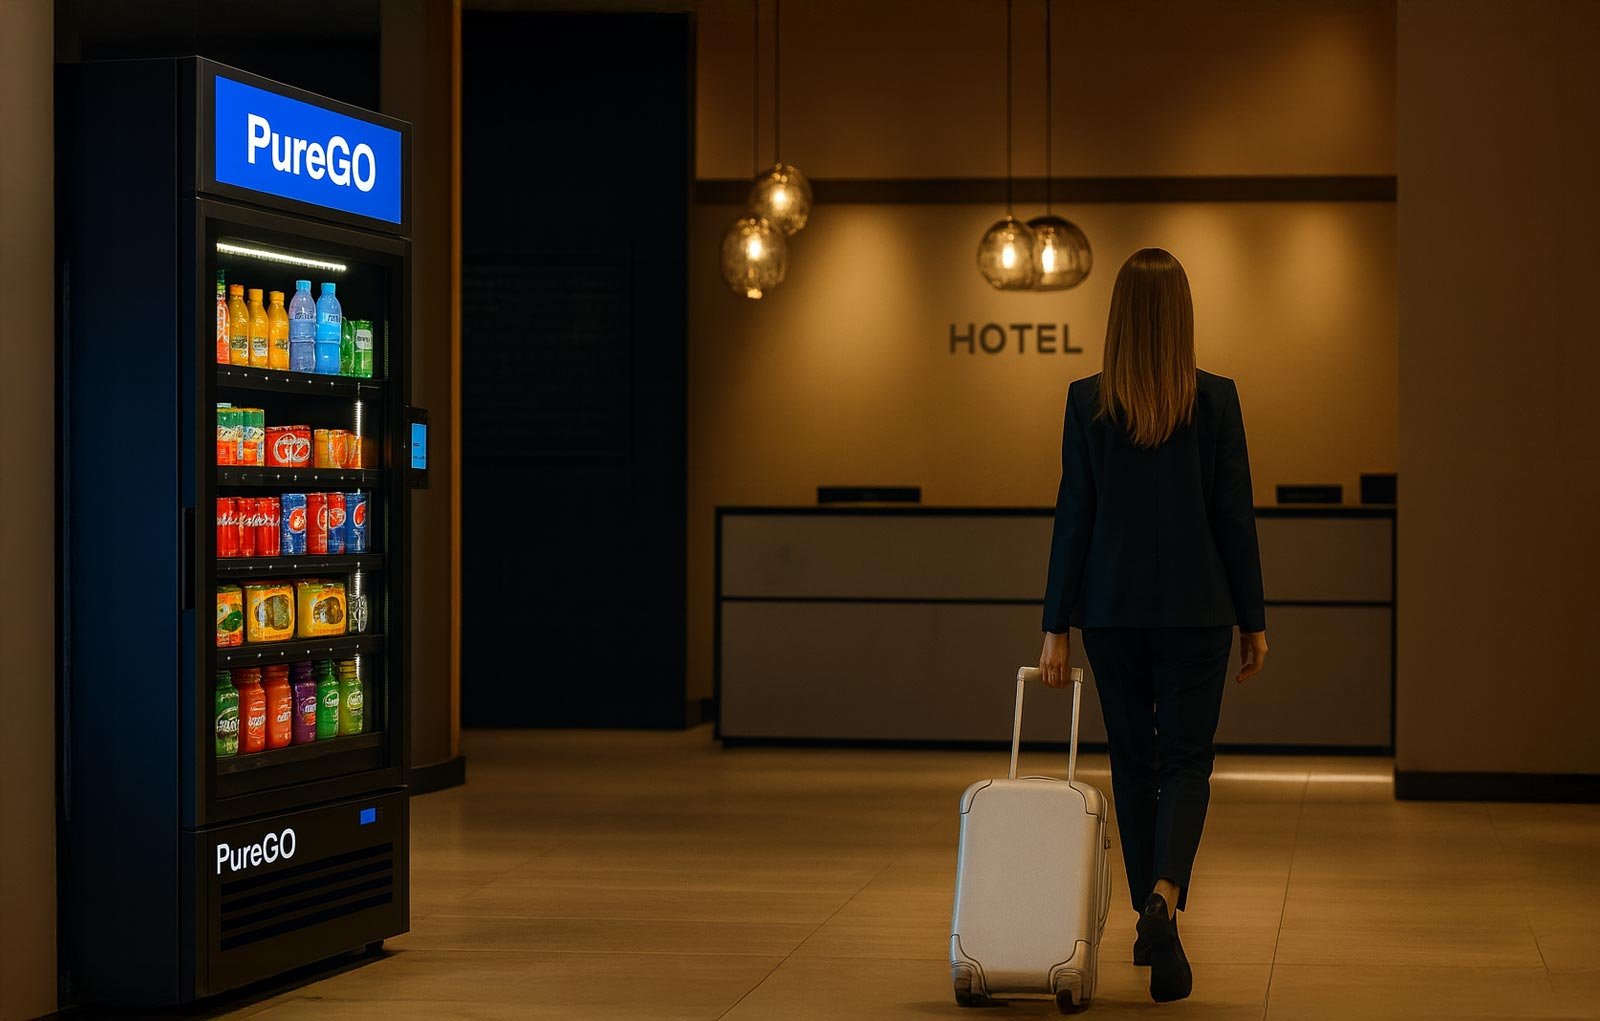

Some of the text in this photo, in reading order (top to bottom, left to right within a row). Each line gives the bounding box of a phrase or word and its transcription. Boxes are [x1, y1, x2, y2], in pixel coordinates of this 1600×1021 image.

[247, 113, 376, 192] PureGO
[949, 323, 1083, 355] HOTEL
[216, 828, 296, 875] PureGO
